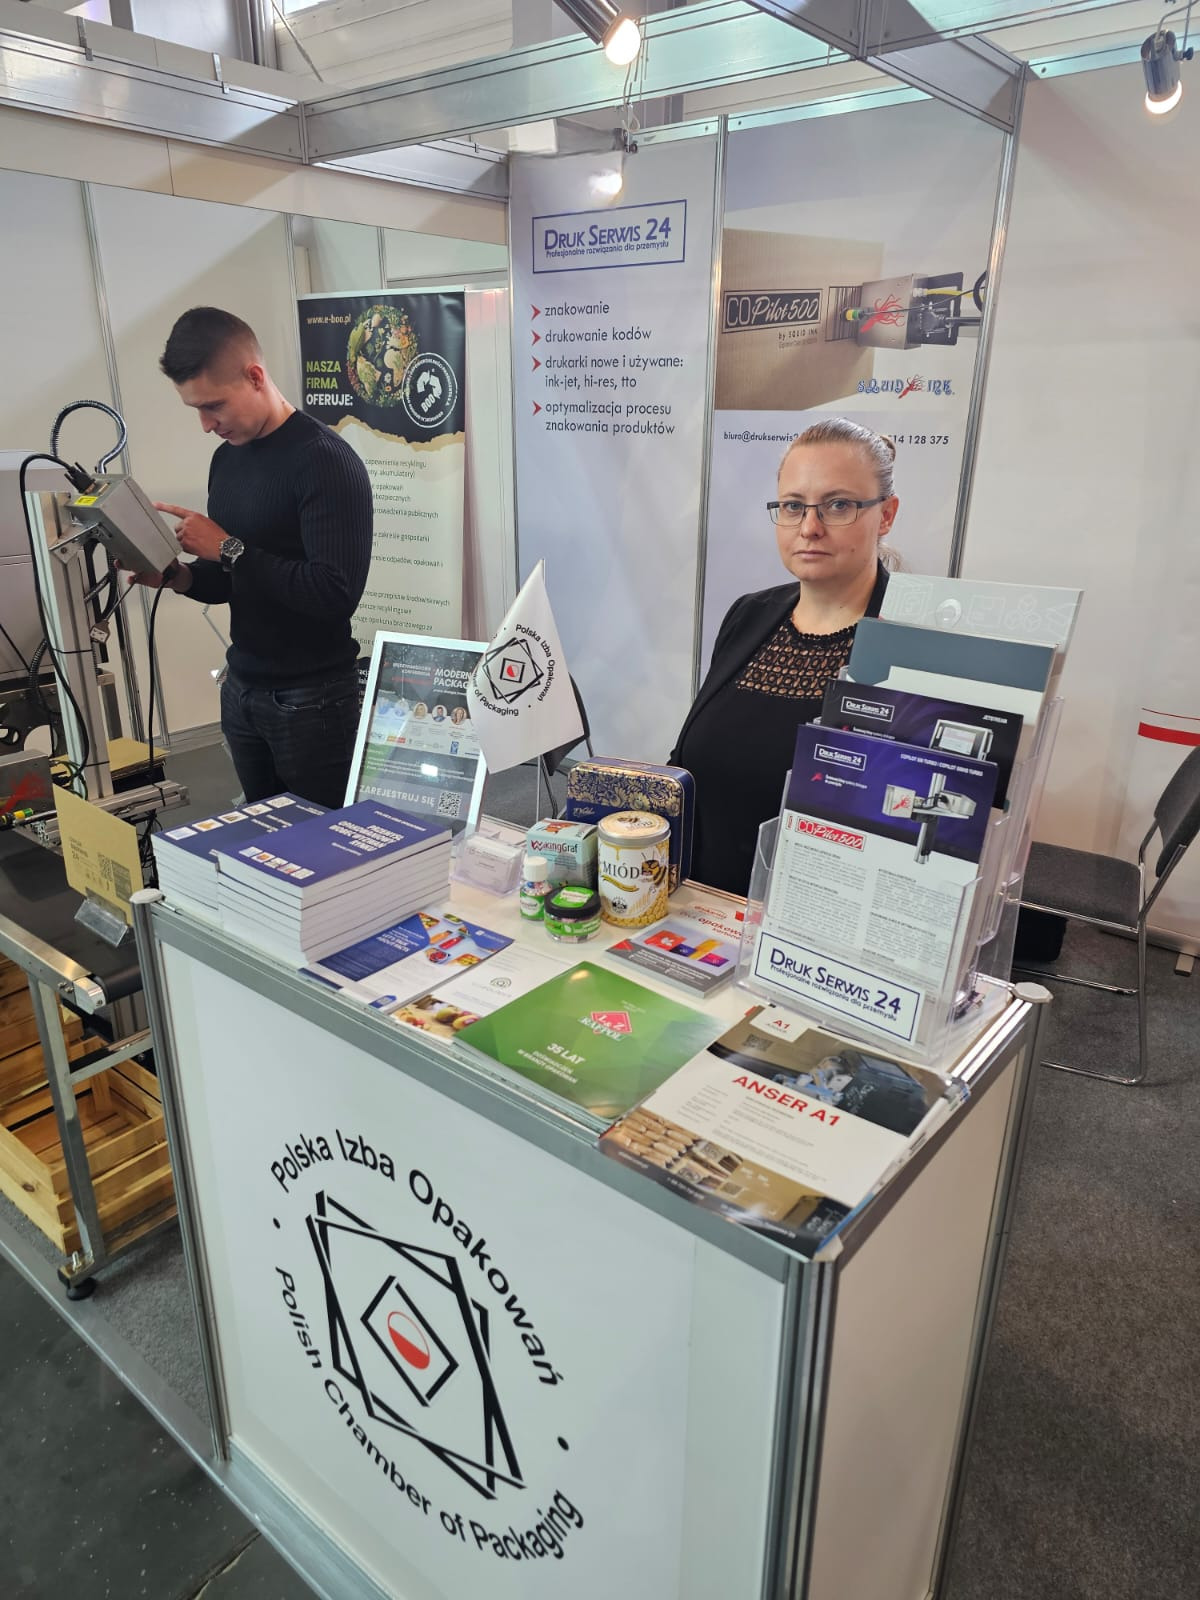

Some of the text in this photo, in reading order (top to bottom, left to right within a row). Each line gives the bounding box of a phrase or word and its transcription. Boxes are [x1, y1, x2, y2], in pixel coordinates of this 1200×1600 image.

[645, 217, 671, 241] 24
[546, 248, 585, 259] Profesjonalne
[624, 243, 634, 251] dla
[544, 301, 610, 316] znakowanie
[306, 313, 351, 325] www.e-boo.pl
[545, 326, 652, 343] drukowanie kodów
[306, 360, 342, 373] NASZA
[545, 355, 684, 372] drukarki nowe i używane:
[306, 377, 338, 390] FIRMA
[545, 374, 637, 391] ink-jet, hi-res, tto
[306, 393, 353, 406] OFERUJE:
[545, 400, 672, 417] optymalizacja procesu
[545, 420, 676, 435] znakowania produktów
[908, 435, 926, 445] 128
[930, 435, 949, 445] 375
[515, 624, 541, 642] Polska
[540, 641, 552, 658] Izba
[433, 677, 469, 689] PACKAG
[480, 696, 519, 716] Packaging
[359, 785, 419, 803] ZAREJESTRUJ
[602, 861, 640, 880] MIÓD
[770, 964, 810, 986] Profesjonalne
[850, 997, 861, 1006] dla
[874, 990, 901, 1014] 24
[772, 1020, 790, 1029] A1
[547, 1043, 586, 1064] 35 LAT
[732, 1076, 840, 1126] ANSER A1
[270, 1129, 564, 1387] Polska Izba Opakowań
[275, 1266, 584, 1560] Polish Chamber of Packaging
